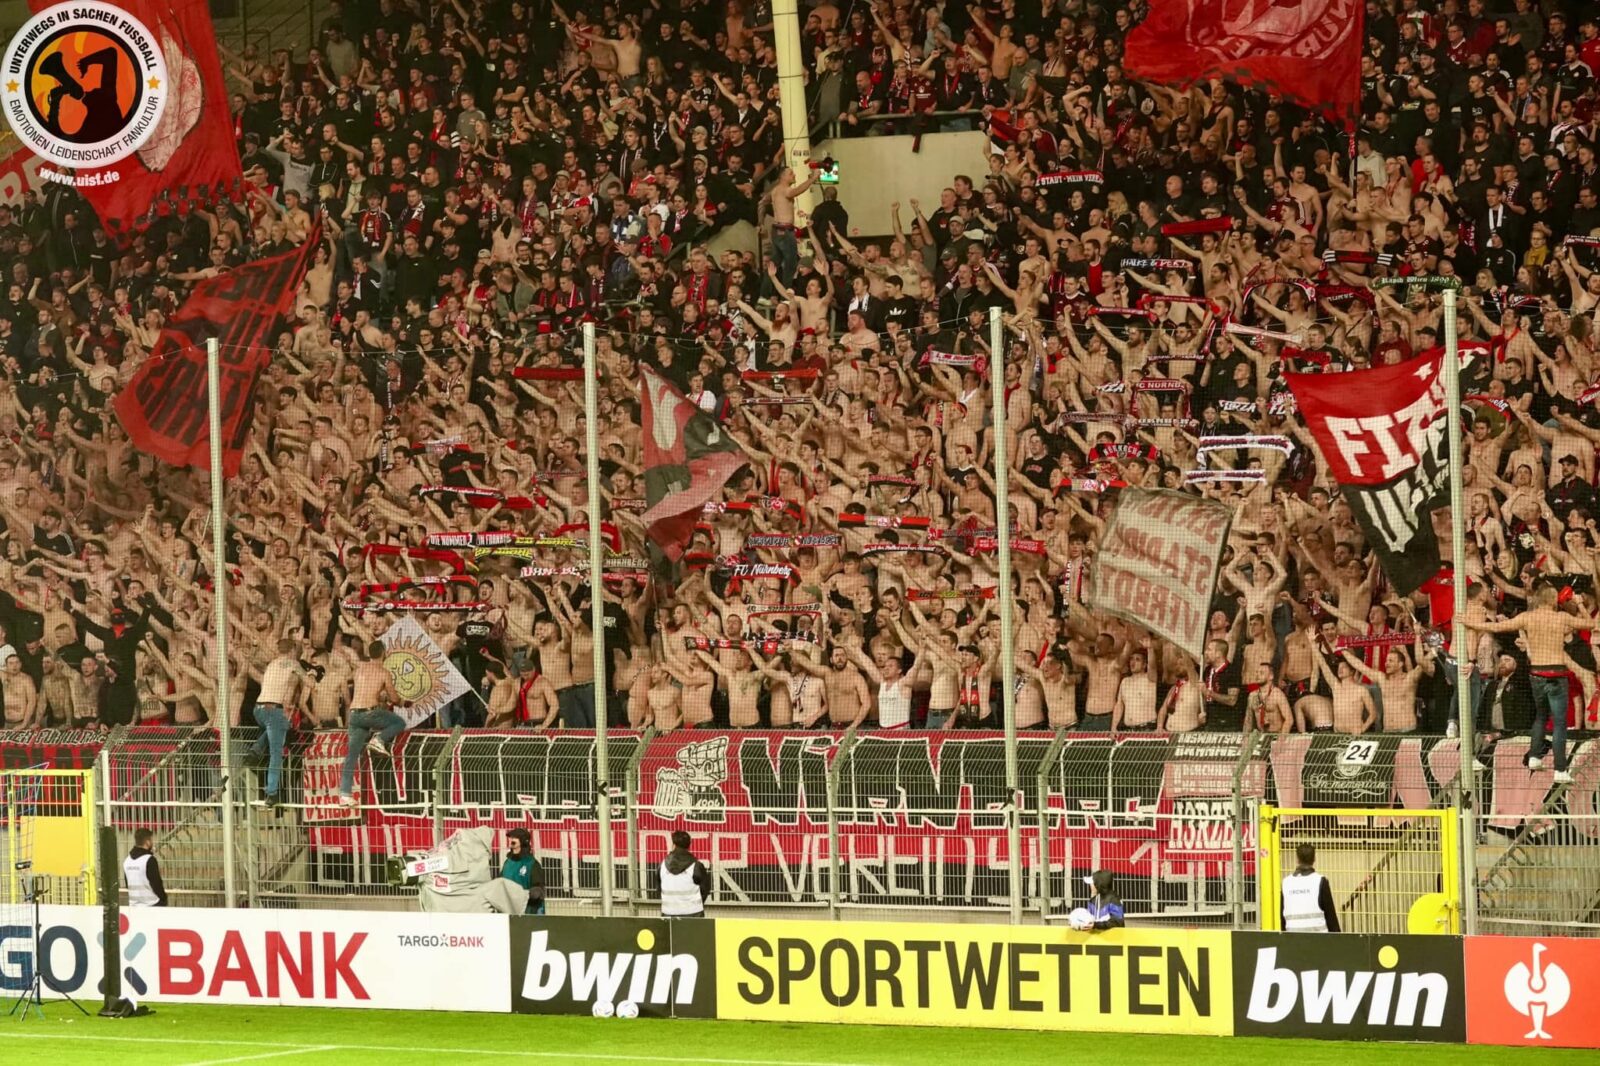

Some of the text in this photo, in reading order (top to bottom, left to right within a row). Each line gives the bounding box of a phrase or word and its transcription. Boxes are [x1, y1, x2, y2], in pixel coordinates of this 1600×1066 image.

[734, 563, 793, 579] FC Nürnberg
[1346, 745, 1372, 760] 24
[157, 928, 371, 1000] BANK
[521, 929, 698, 1005] bwin
[737, 936, 1211, 1017] SPORTWETTEN
[1247, 945, 1448, 1027] bwin
